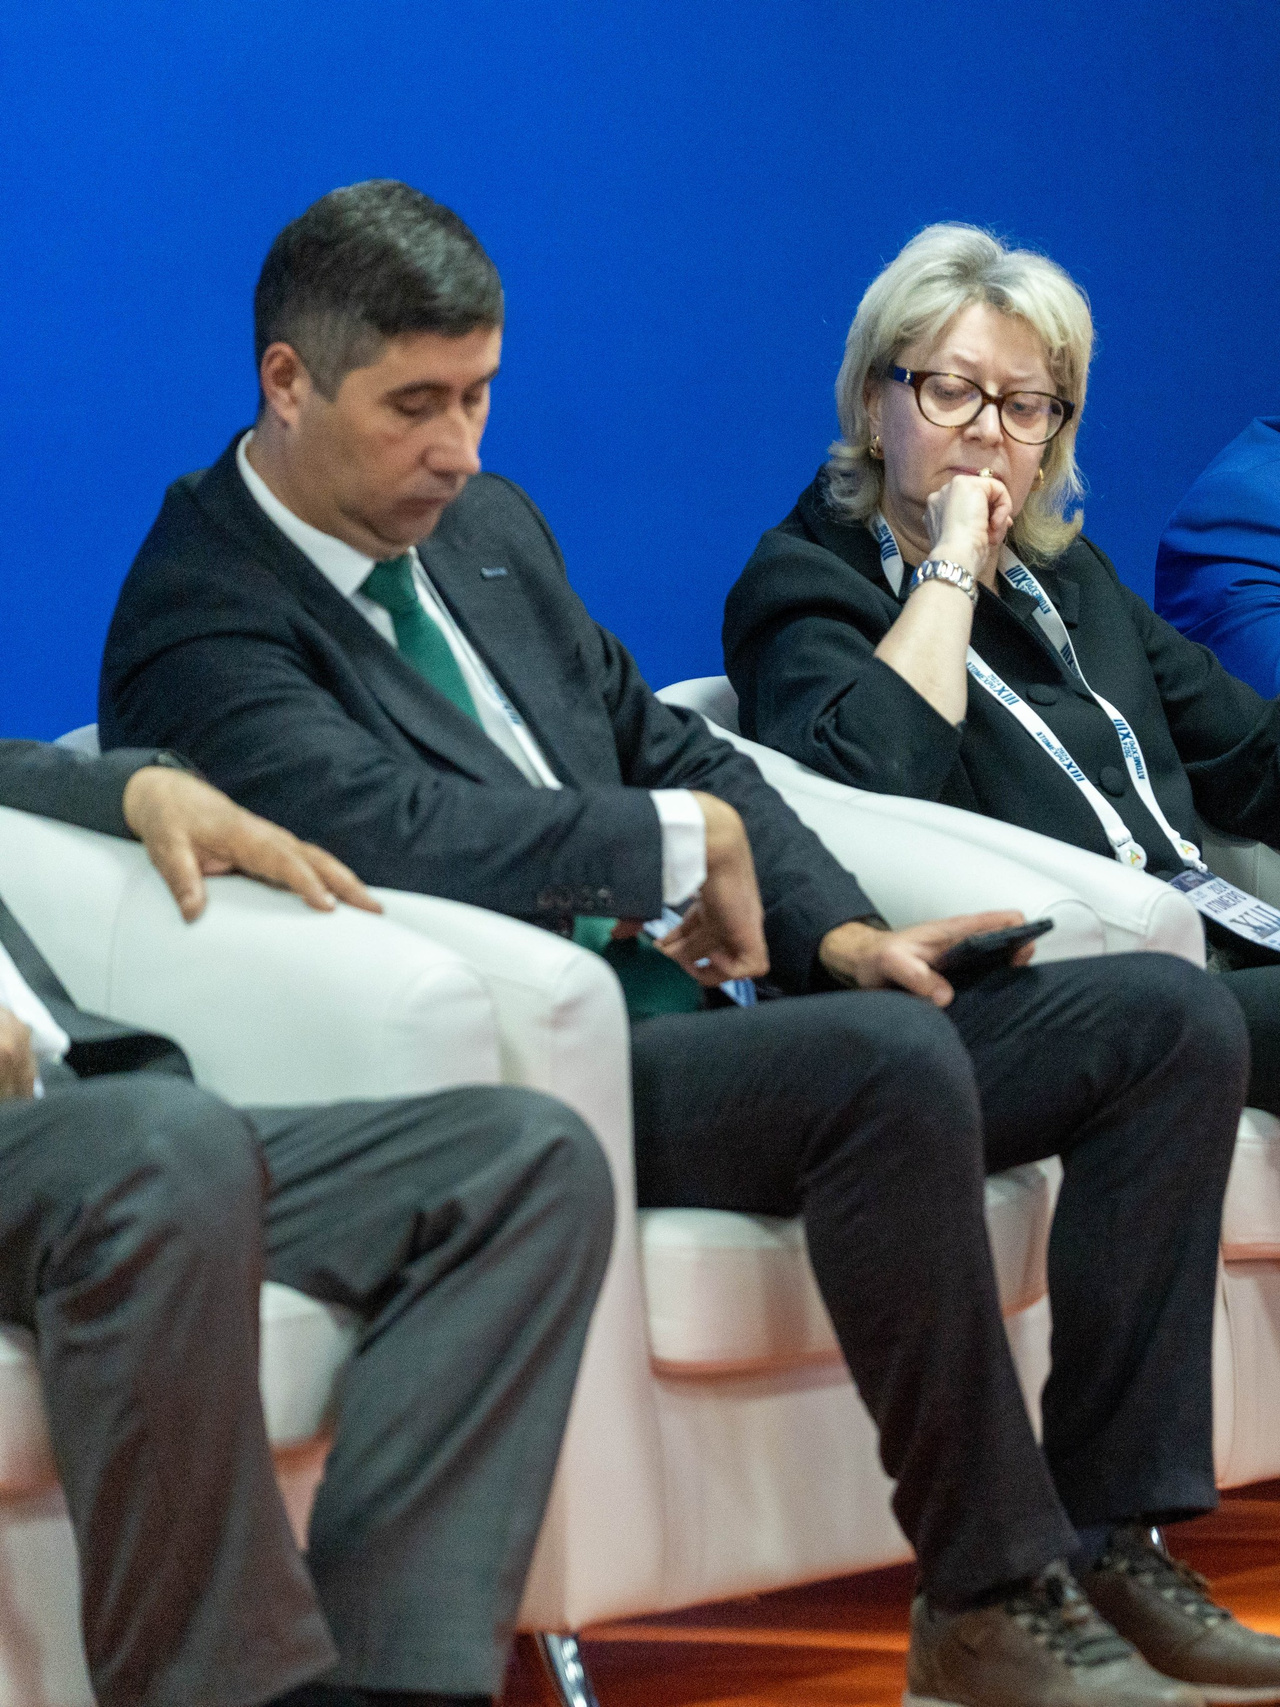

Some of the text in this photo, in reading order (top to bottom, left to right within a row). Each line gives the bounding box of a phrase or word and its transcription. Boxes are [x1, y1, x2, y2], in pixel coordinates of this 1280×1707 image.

[1004, 563, 1030, 586] XIII
[993, 685, 1020, 706] XIII
[1113, 718, 1132, 740] XIII
[1035, 730, 1064, 763] ATOMEXPO
[1122, 742, 1131, 758] 2024
[1128, 739, 1145, 779] ATOMEXPO
[1062, 760, 1085, 782] XIII
